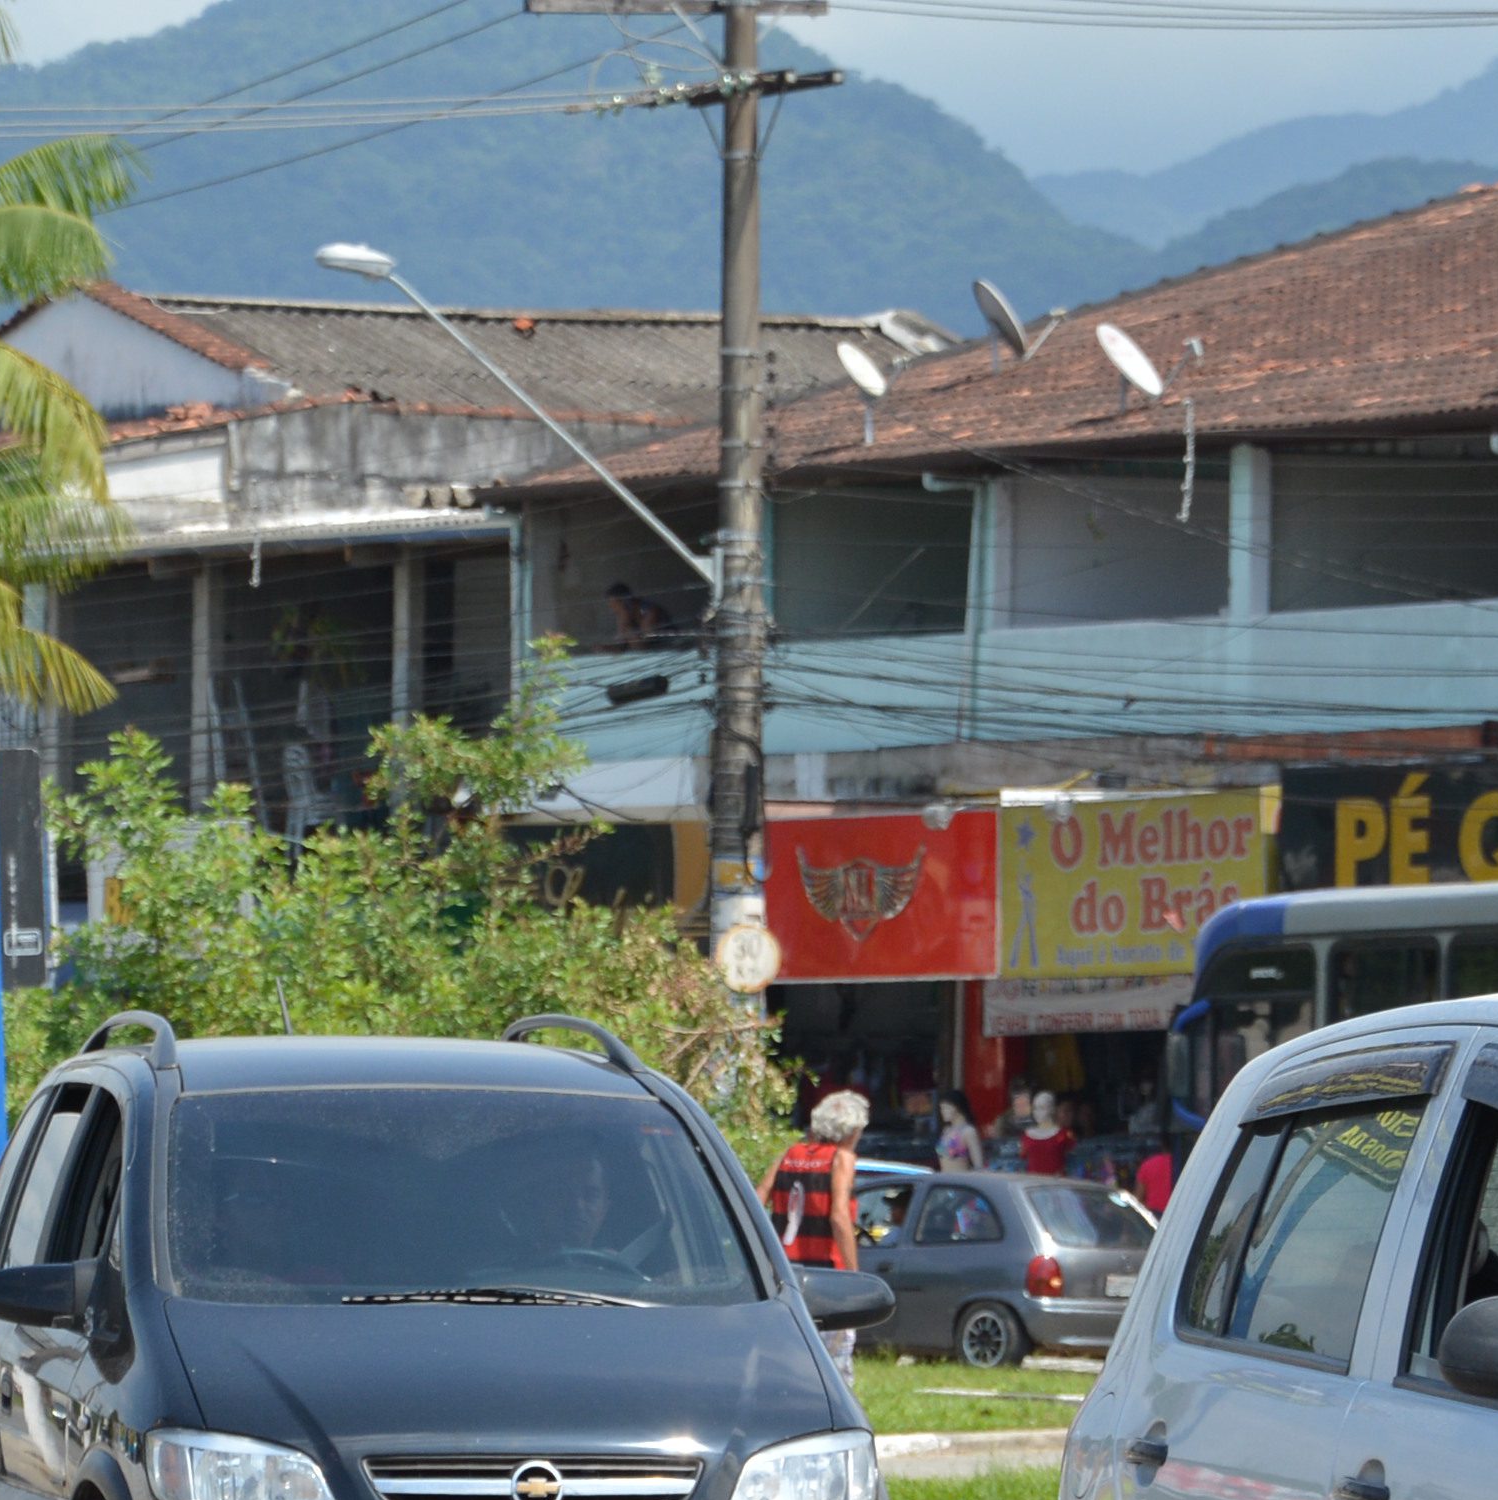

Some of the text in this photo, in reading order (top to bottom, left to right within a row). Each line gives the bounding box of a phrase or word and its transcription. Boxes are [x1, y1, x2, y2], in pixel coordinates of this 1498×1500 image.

[1051, 807, 1256, 870] O Melhor
[1335, 773, 1431, 887] PÉ
[1072, 880, 1125, 933] do
